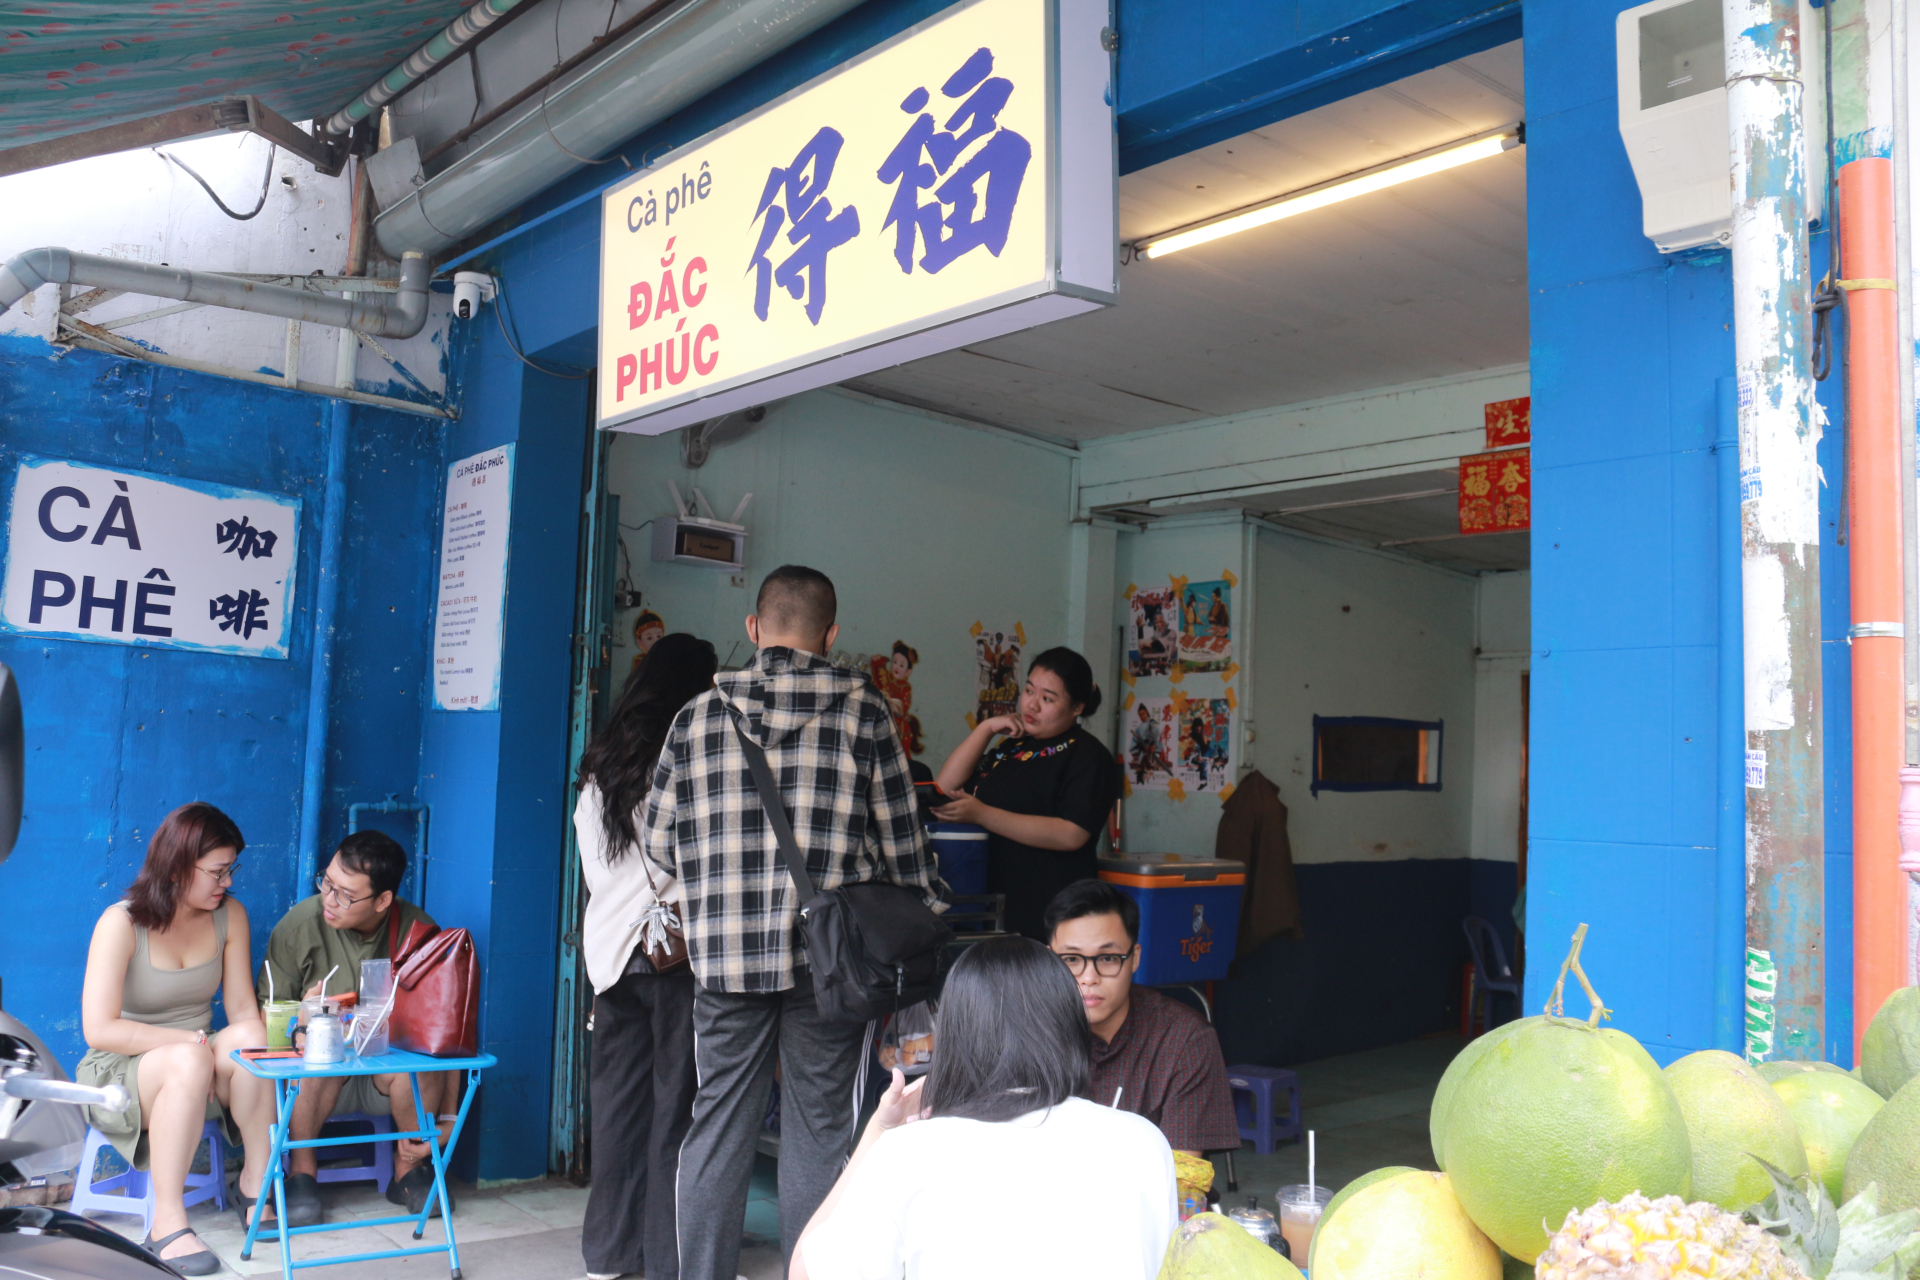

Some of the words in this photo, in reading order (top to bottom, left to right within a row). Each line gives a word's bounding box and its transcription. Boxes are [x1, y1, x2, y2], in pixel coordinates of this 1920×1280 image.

[627, 189, 657, 233] Cà
[665, 160, 712, 226] phê
[743, 47, 1032, 326] 得福
[627, 235, 707, 331] ĐẮC
[616, 316, 719, 403] PHÚC
[38, 480, 142, 551] CÀ
[29, 568, 176, 638] PHÊ
[1180, 937, 1214, 962] Tiger
